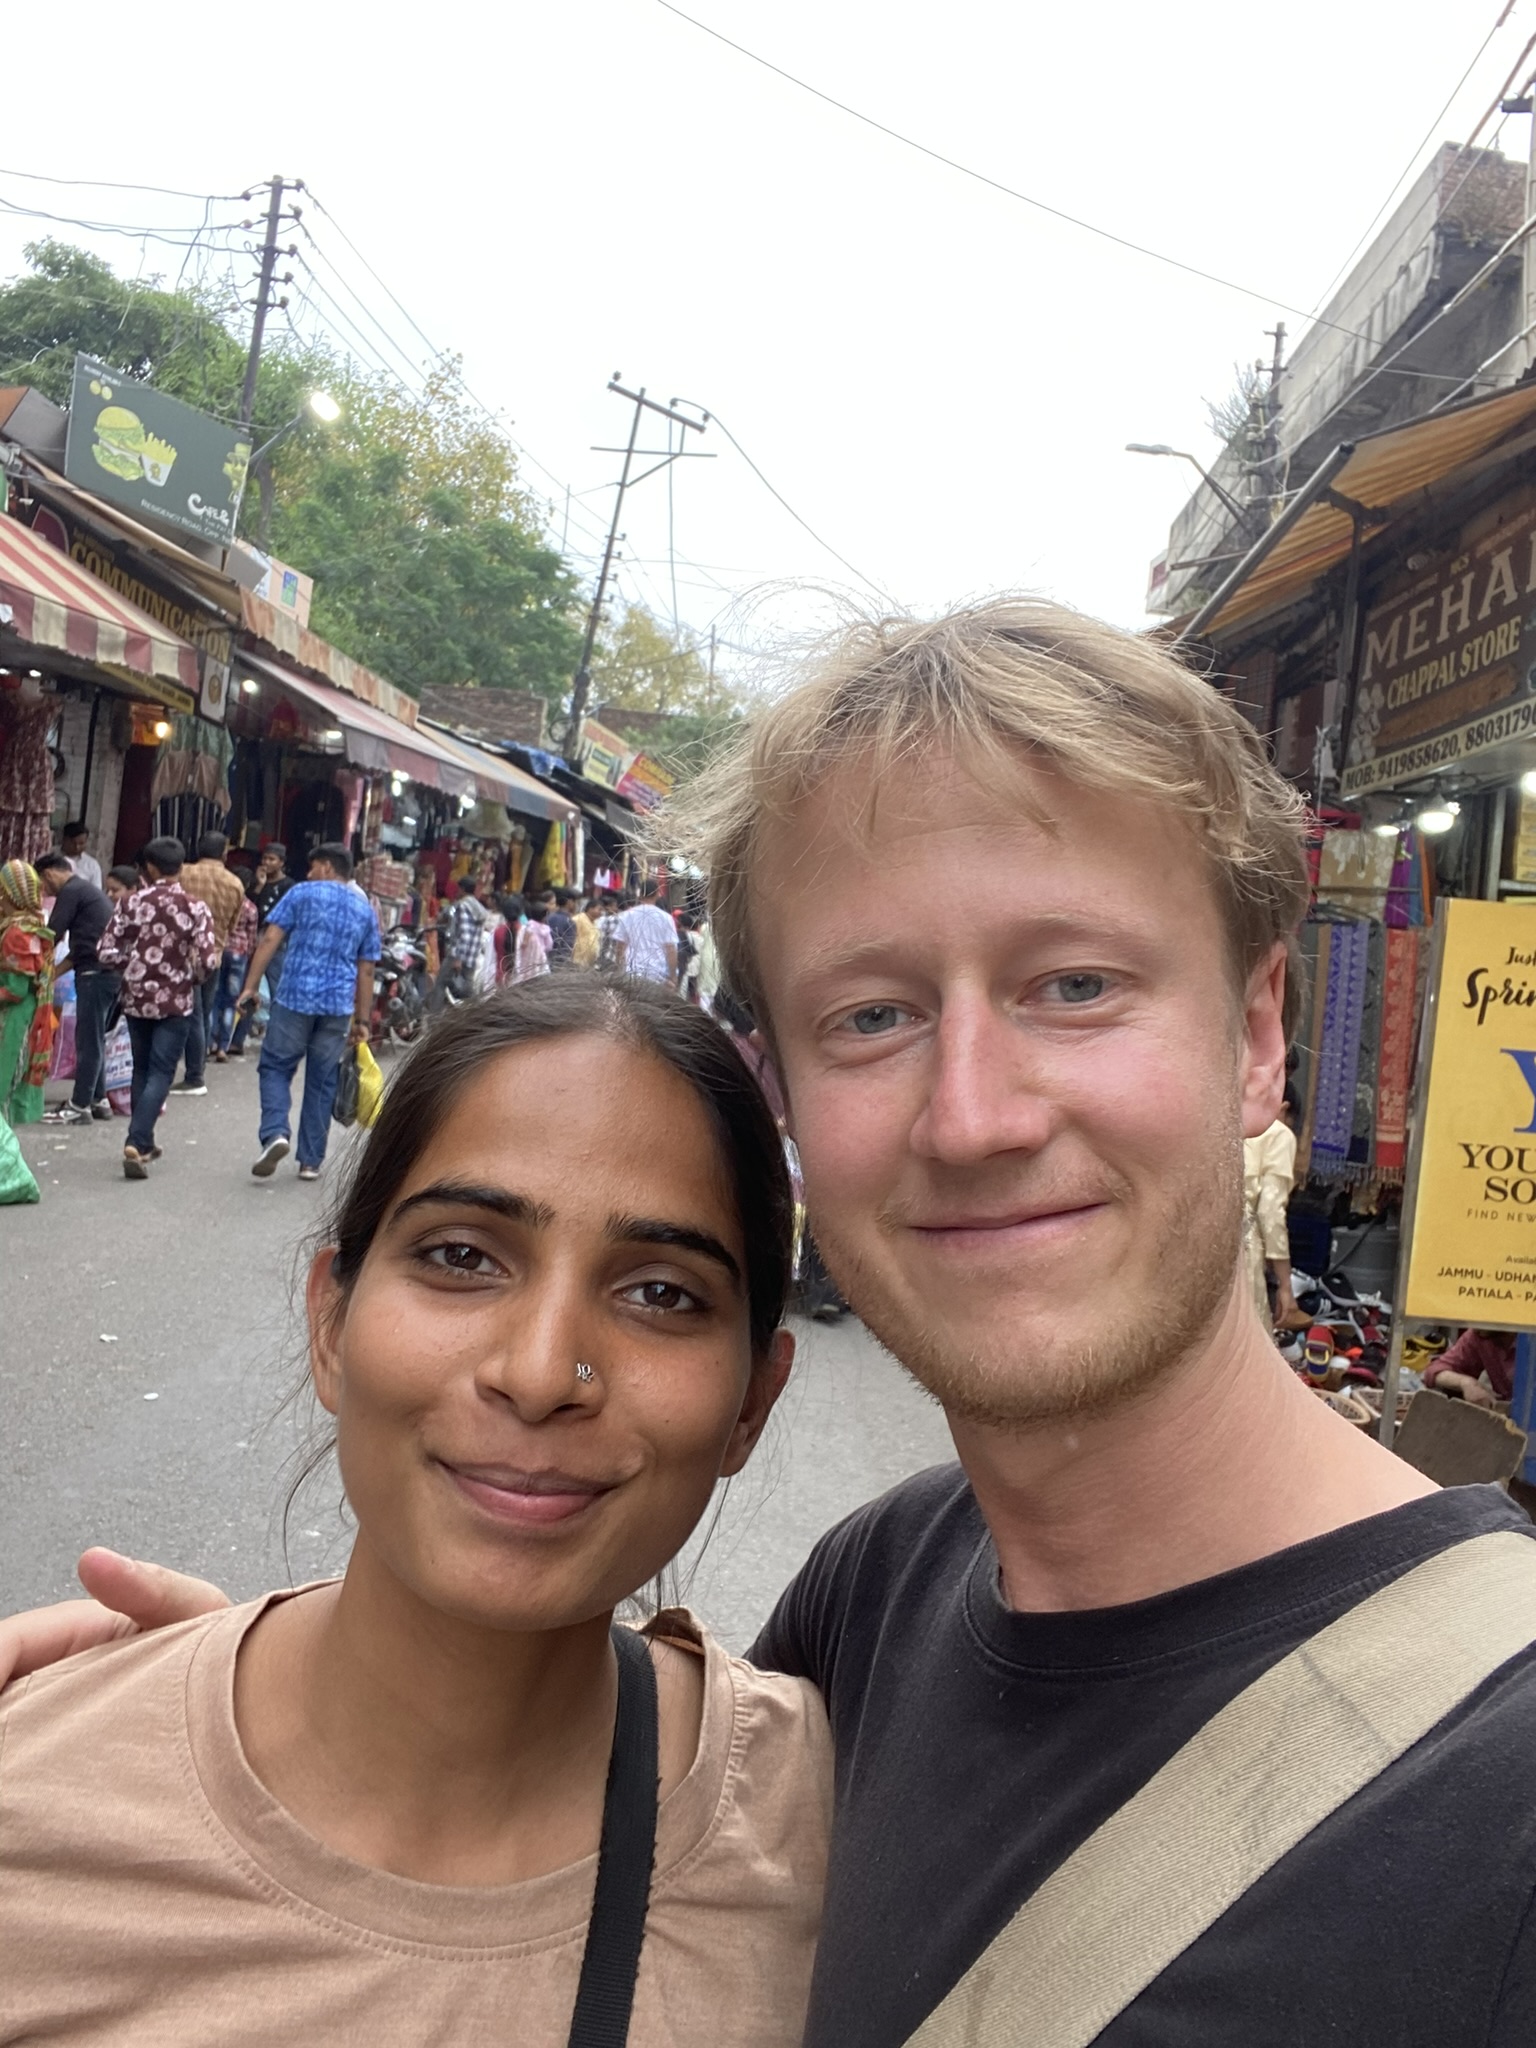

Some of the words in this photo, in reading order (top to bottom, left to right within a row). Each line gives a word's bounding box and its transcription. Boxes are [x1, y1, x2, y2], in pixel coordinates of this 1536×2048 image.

[1387, 651, 1458, 710] CHAPPAL
[1460, 615, 1522, 678] STORE
[1457, 1142, 1536, 1175] YOU
[1483, 1176, 1536, 1206] SO
[1466, 1208, 1499, 1220] FIND
[1506, 1211, 1536, 1223] NEW
[1437, 1266, 1484, 1280] JAMMU
[1458, 1286, 1514, 1301] PATIALA
